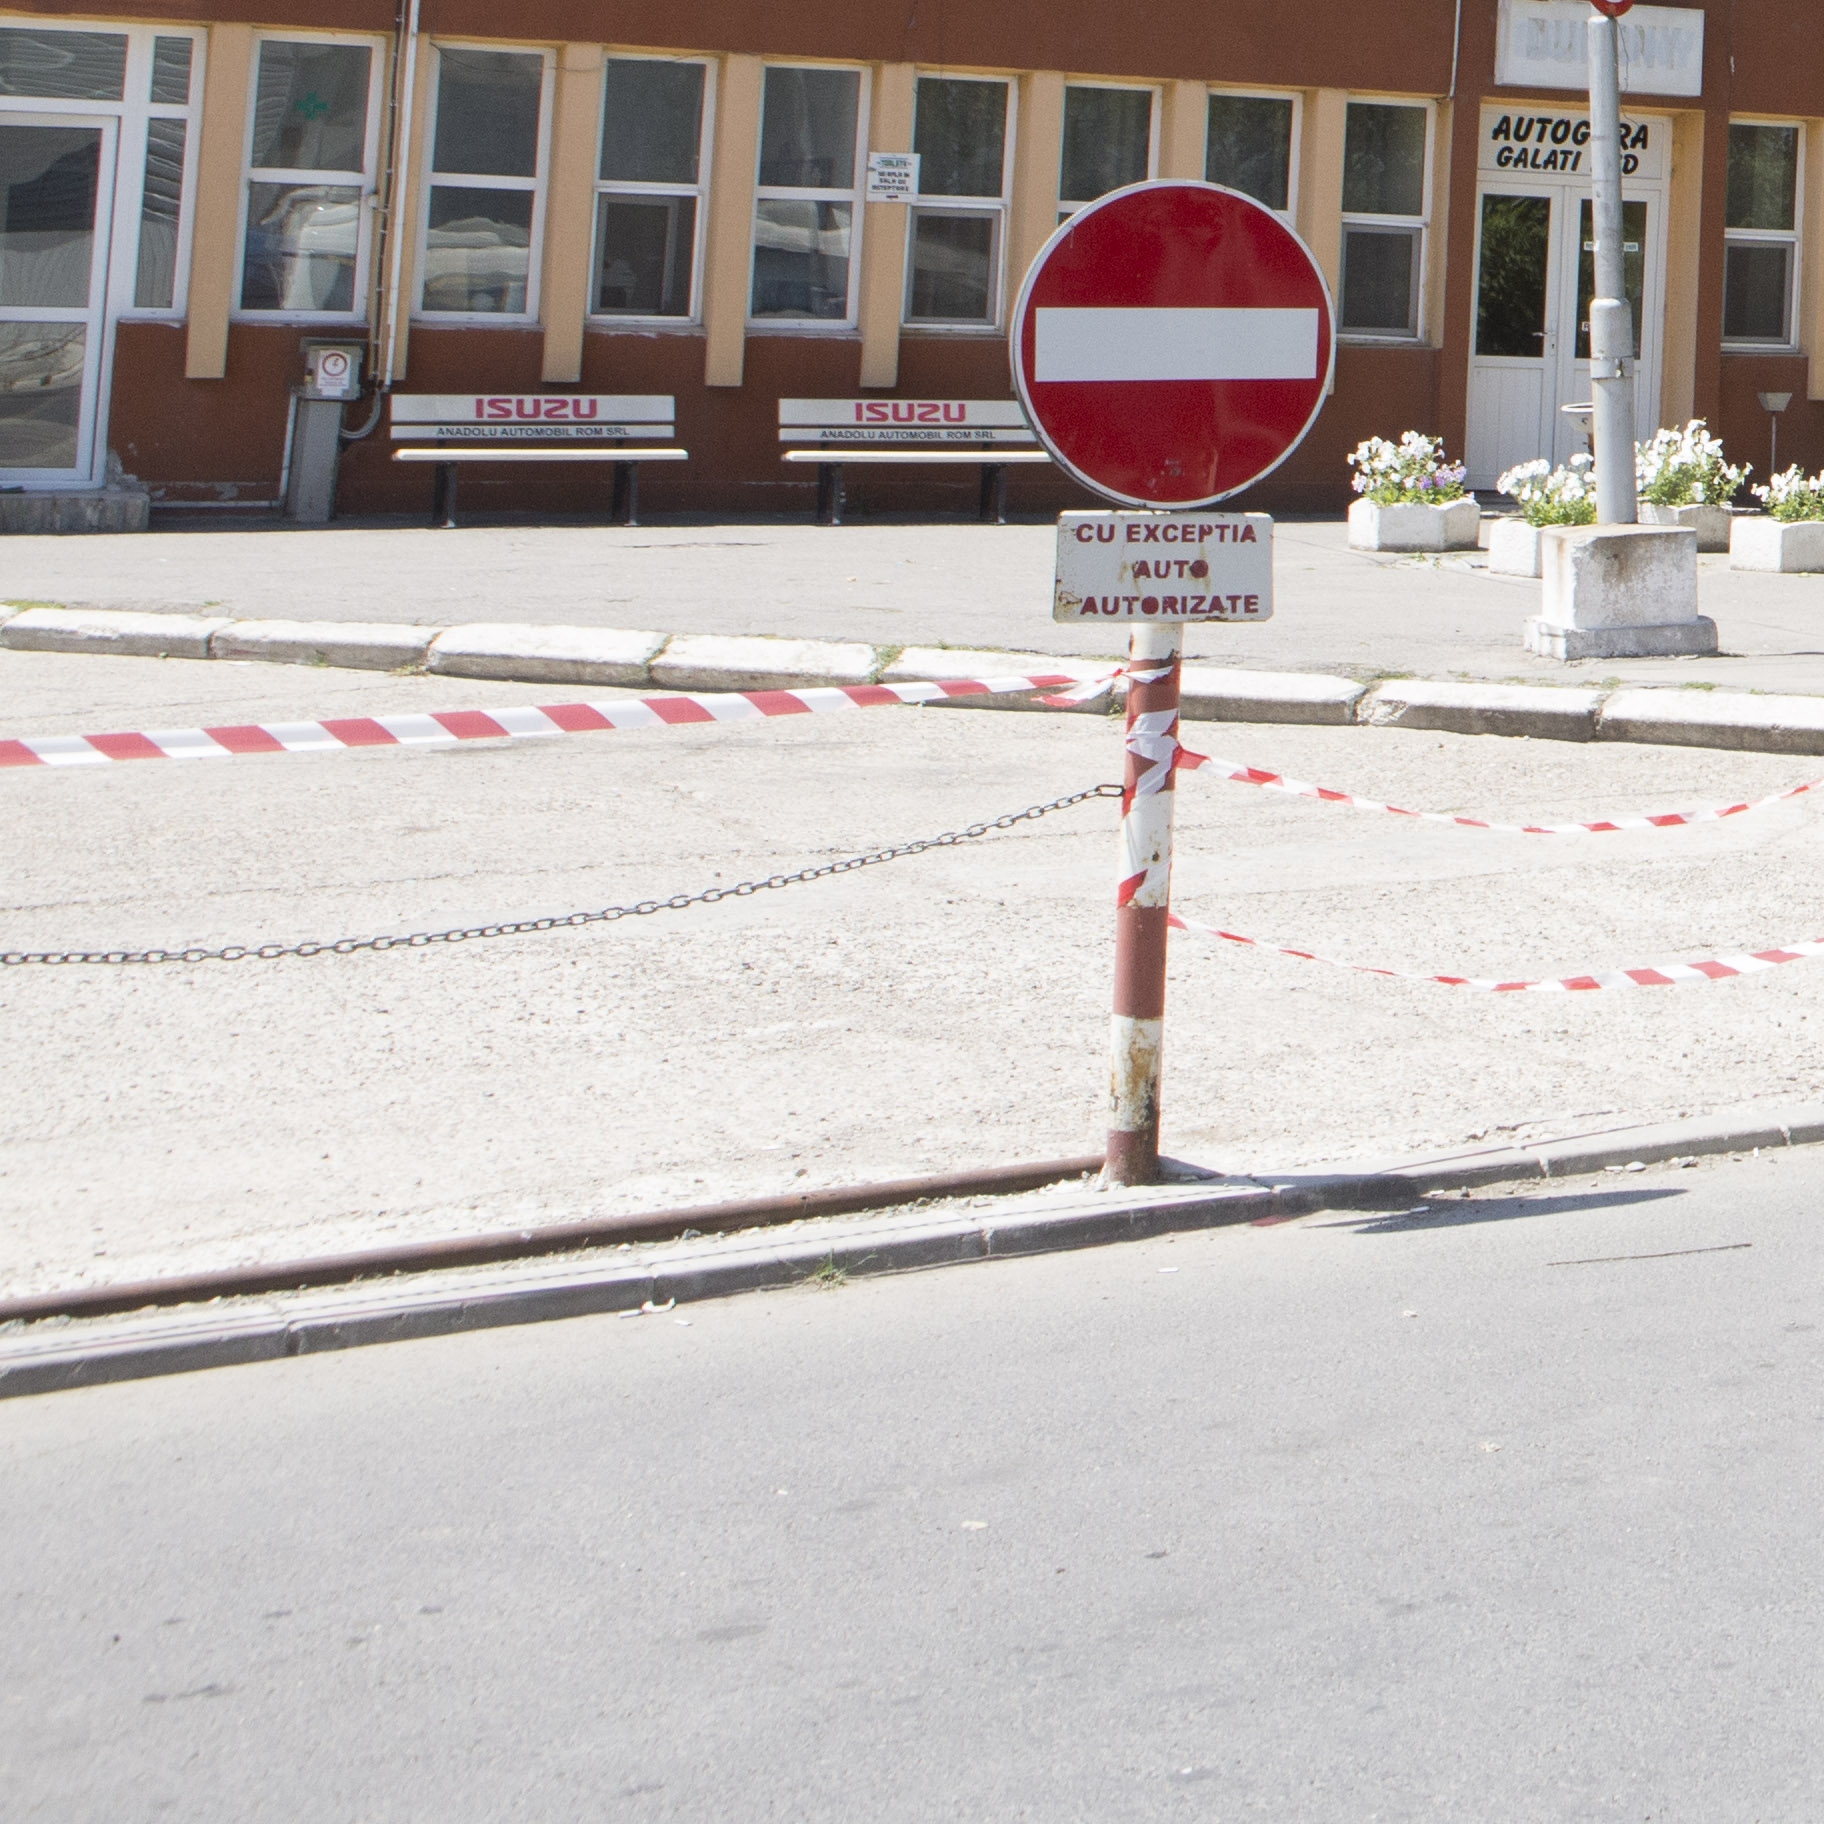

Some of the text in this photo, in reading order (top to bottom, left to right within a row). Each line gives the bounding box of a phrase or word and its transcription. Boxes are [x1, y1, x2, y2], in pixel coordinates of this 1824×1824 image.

[1491, 115, 1649, 150] AUTOGRA
[1496, 145, 1583, 172] GALATI
[475, 398, 598, 419] ISUZU
[855, 402, 966, 423] ISUZU
[436, 427, 630, 437] ANADOLU AUTOMOBIL ROM SRL
[819, 430, 996, 440] ANADOLU AUTOMOBIL ROM SRL
[1075, 523, 1258, 544] CU EXCEPTIA
[1132, 559, 1209, 579] AUTO
[1080, 594, 1259, 616] AUTORIZATE
